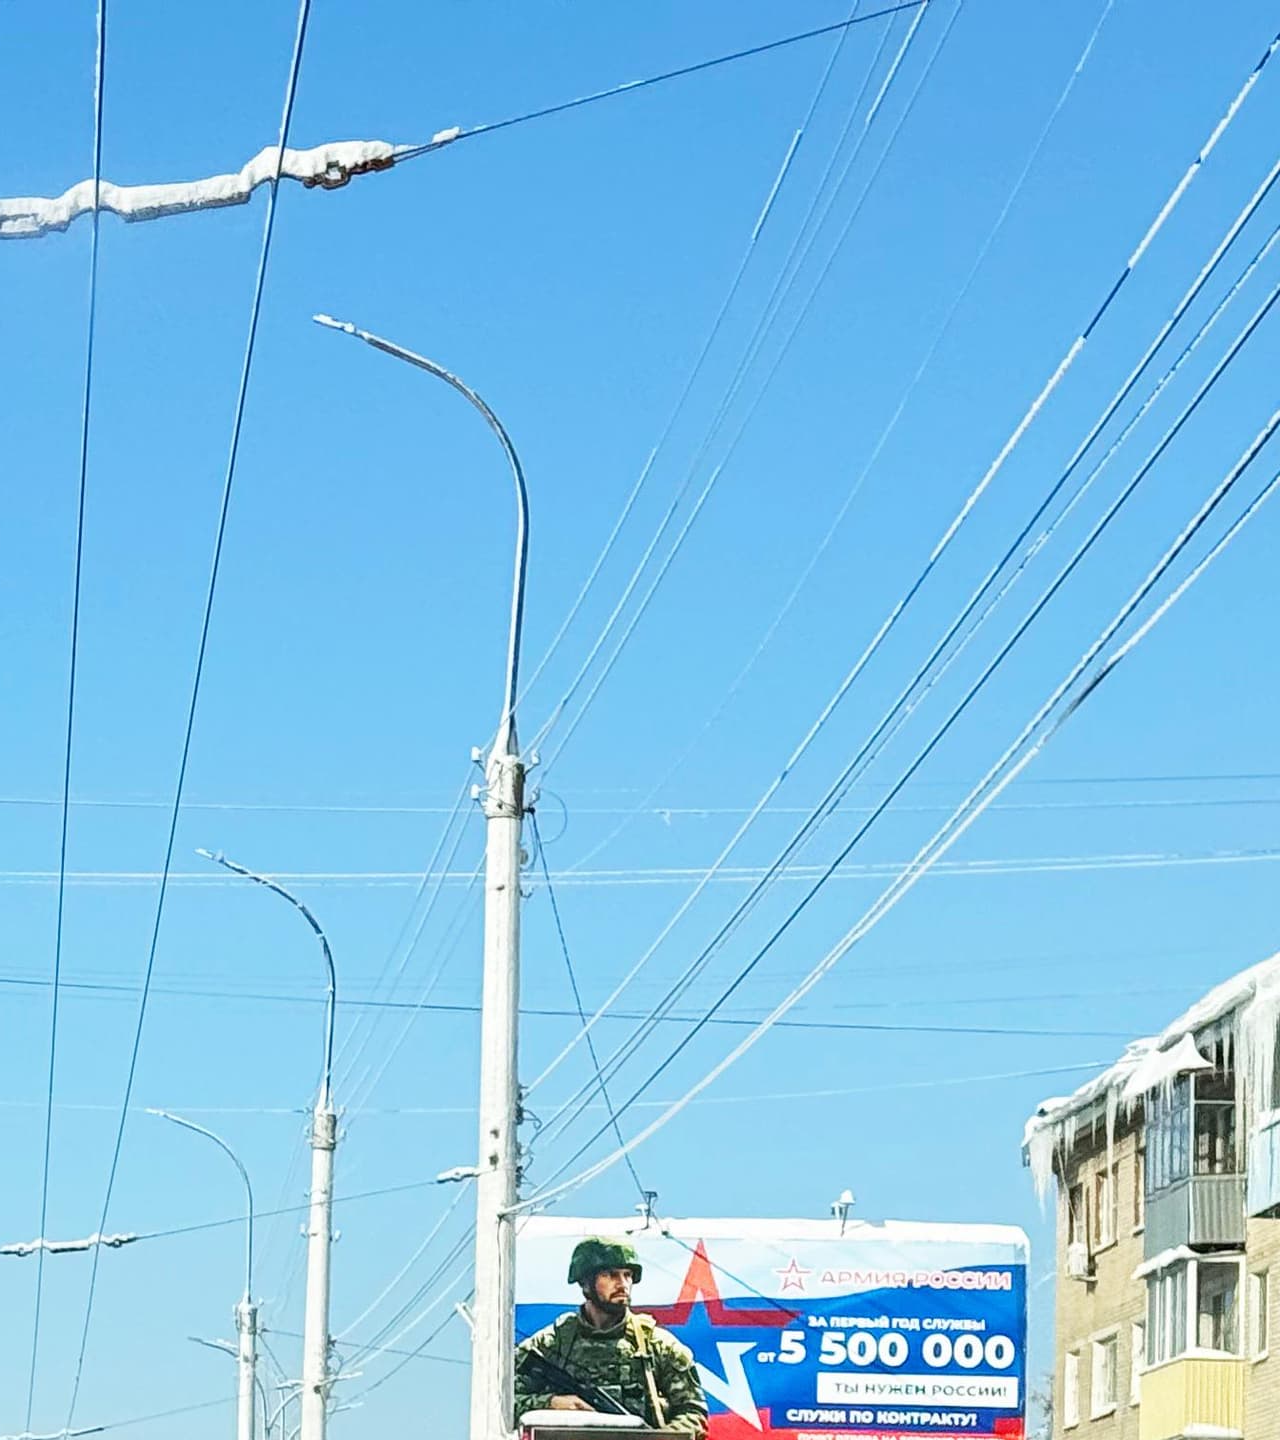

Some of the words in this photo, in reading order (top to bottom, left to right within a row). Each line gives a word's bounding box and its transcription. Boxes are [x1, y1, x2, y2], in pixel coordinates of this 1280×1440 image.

[821, 1271, 906, 1286] АРМИЯ
[914, 1271, 1012, 1290] РОССИИ
[808, 1316, 828, 1328] ЗА
[830, 1315, 889, 1329] ПЕРВЫЙ
[892, 1317, 920, 1331] ГОД
[922, 1318, 986, 1331] СЛУЖБЫ
[777, 1330, 807, 1364] 5
[819, 1331, 909, 1368] 500
[922, 1333, 1016, 1369] 000
[834, 1383, 858, 1394] ТЫ
[865, 1384, 926, 1395] НУЖЕН
[932, 1384, 1007, 1397] РОССИИ!
[786, 1409, 846, 1423] СЛУЖИ
[849, 1410, 872, 1423] ПО
[877, 1410, 977, 1427] КОНТРАКТУ!
